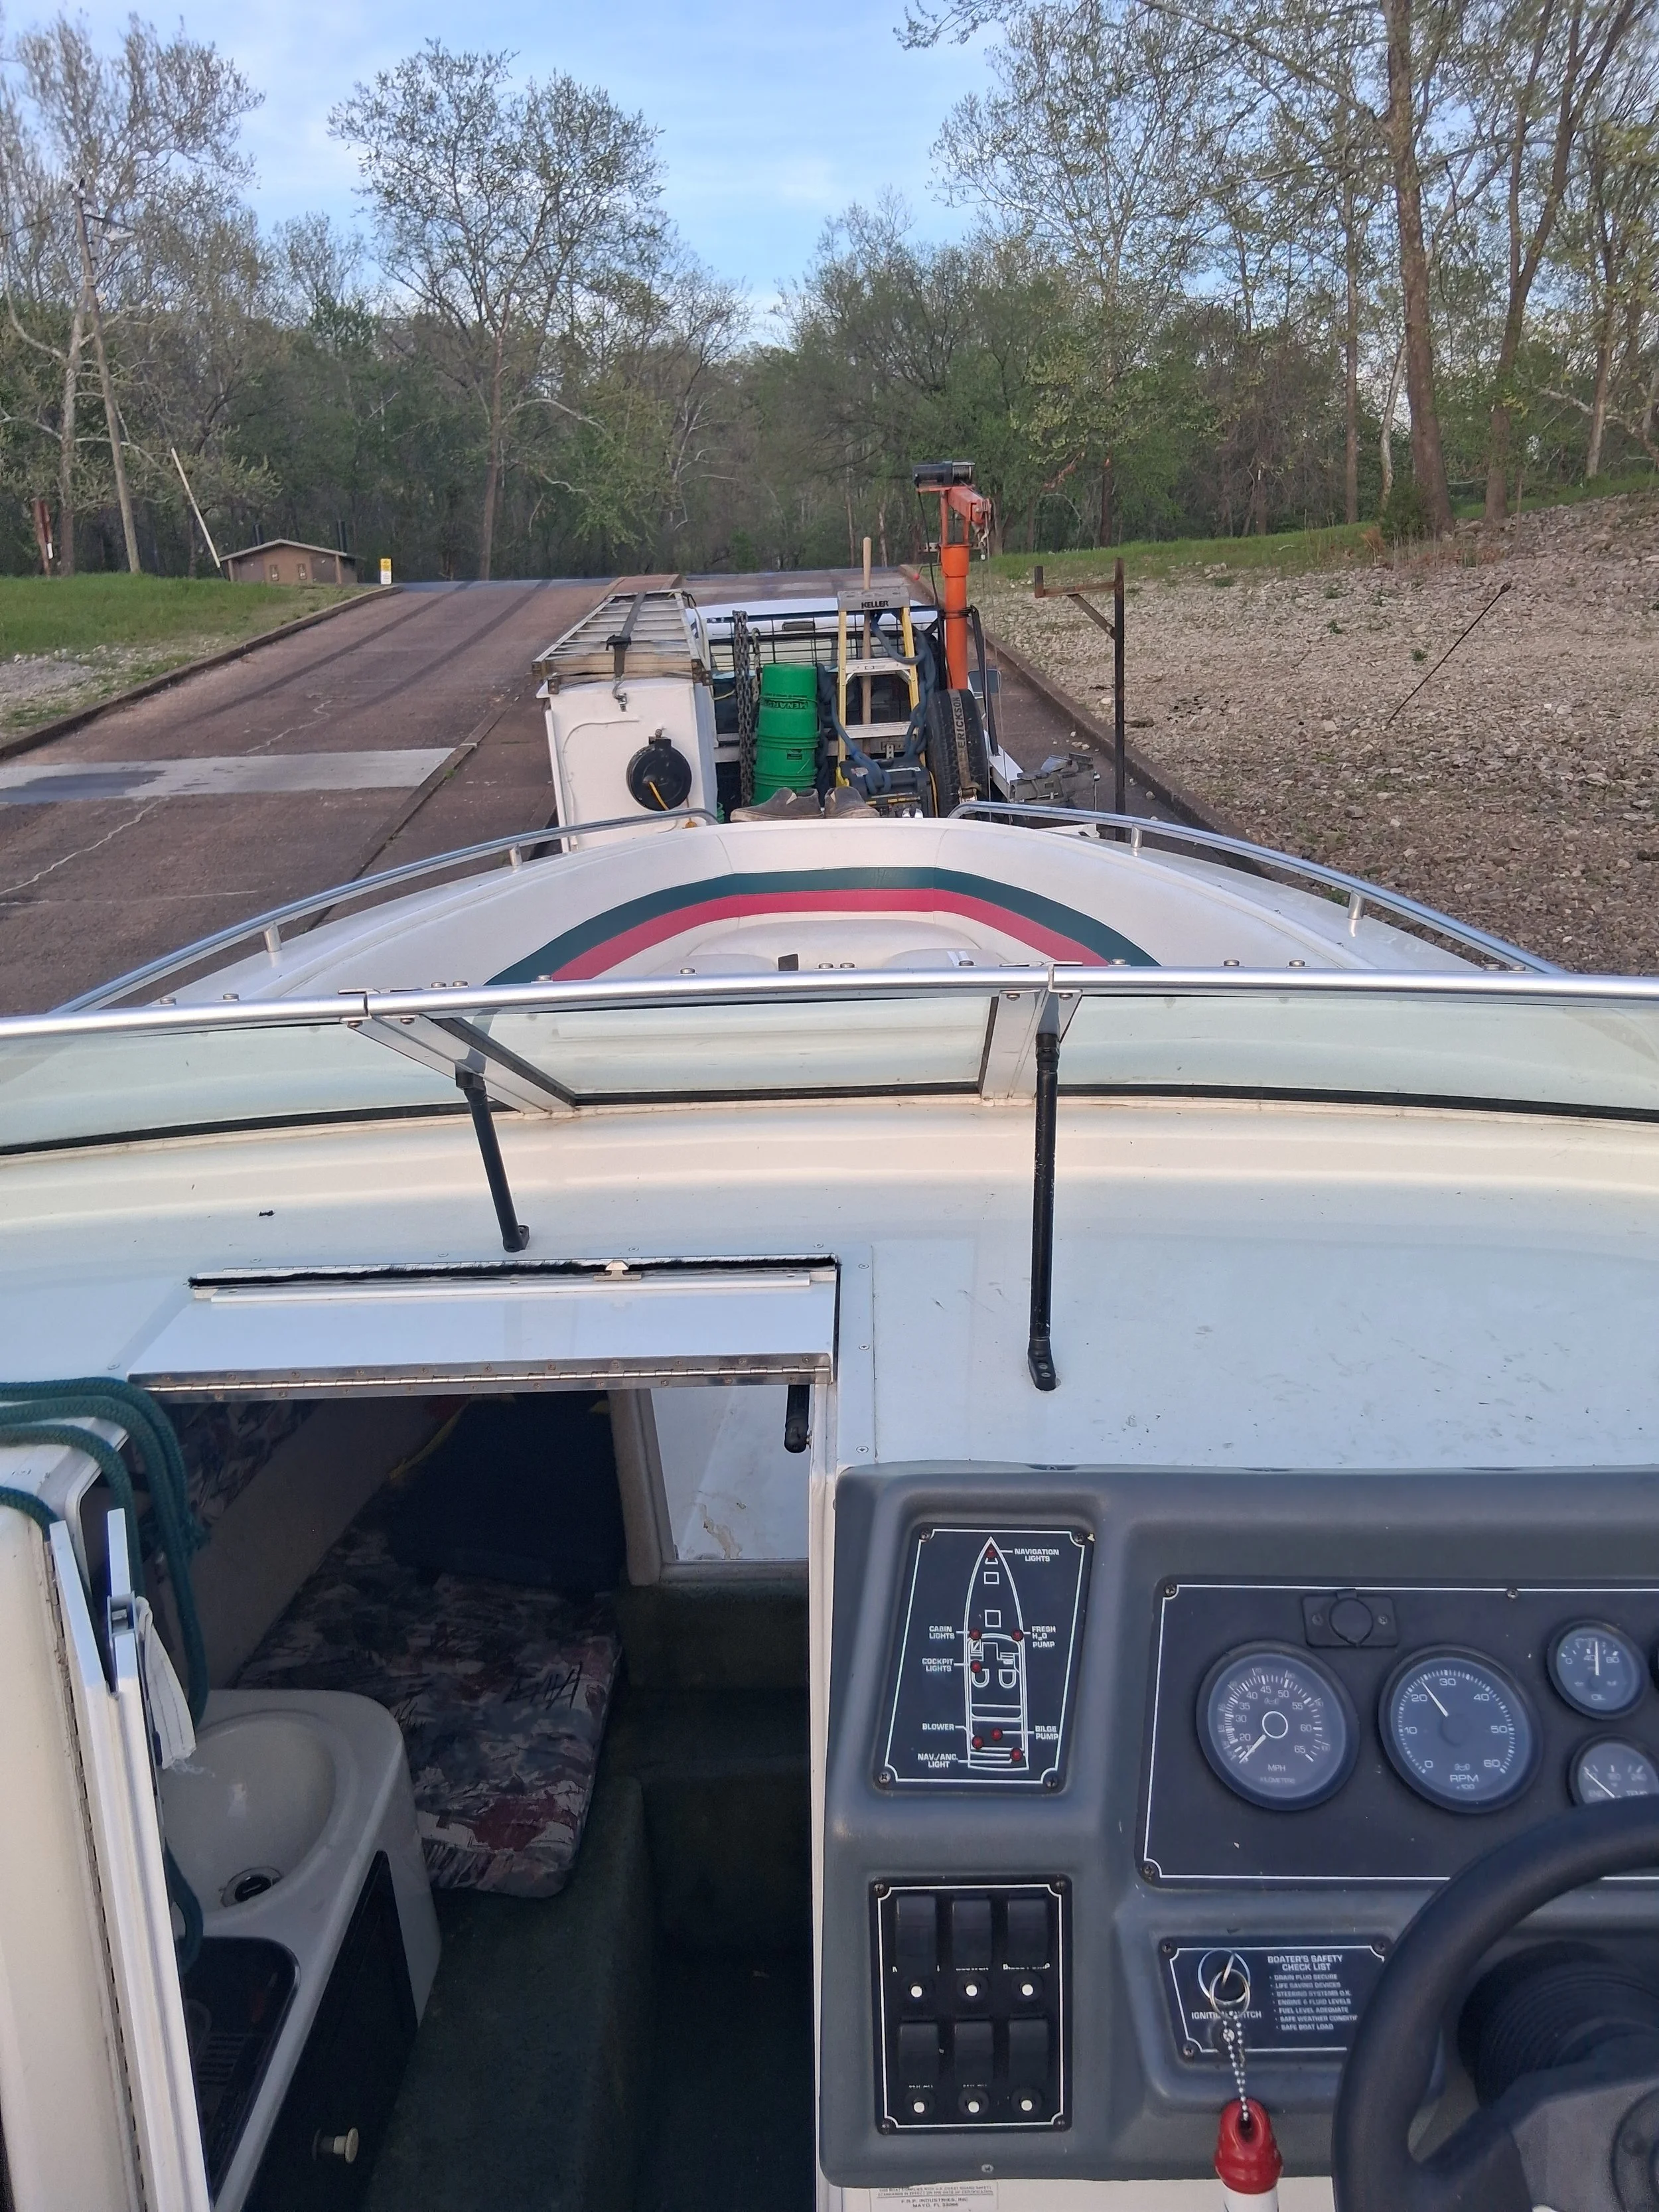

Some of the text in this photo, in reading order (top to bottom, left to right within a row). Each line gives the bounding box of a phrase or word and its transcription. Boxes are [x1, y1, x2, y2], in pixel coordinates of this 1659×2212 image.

[861, 600, 889, 609] KELLER
[952, 697, 966, 749] ERICKSON
[1484, 1759, 1500, 1767] 60
